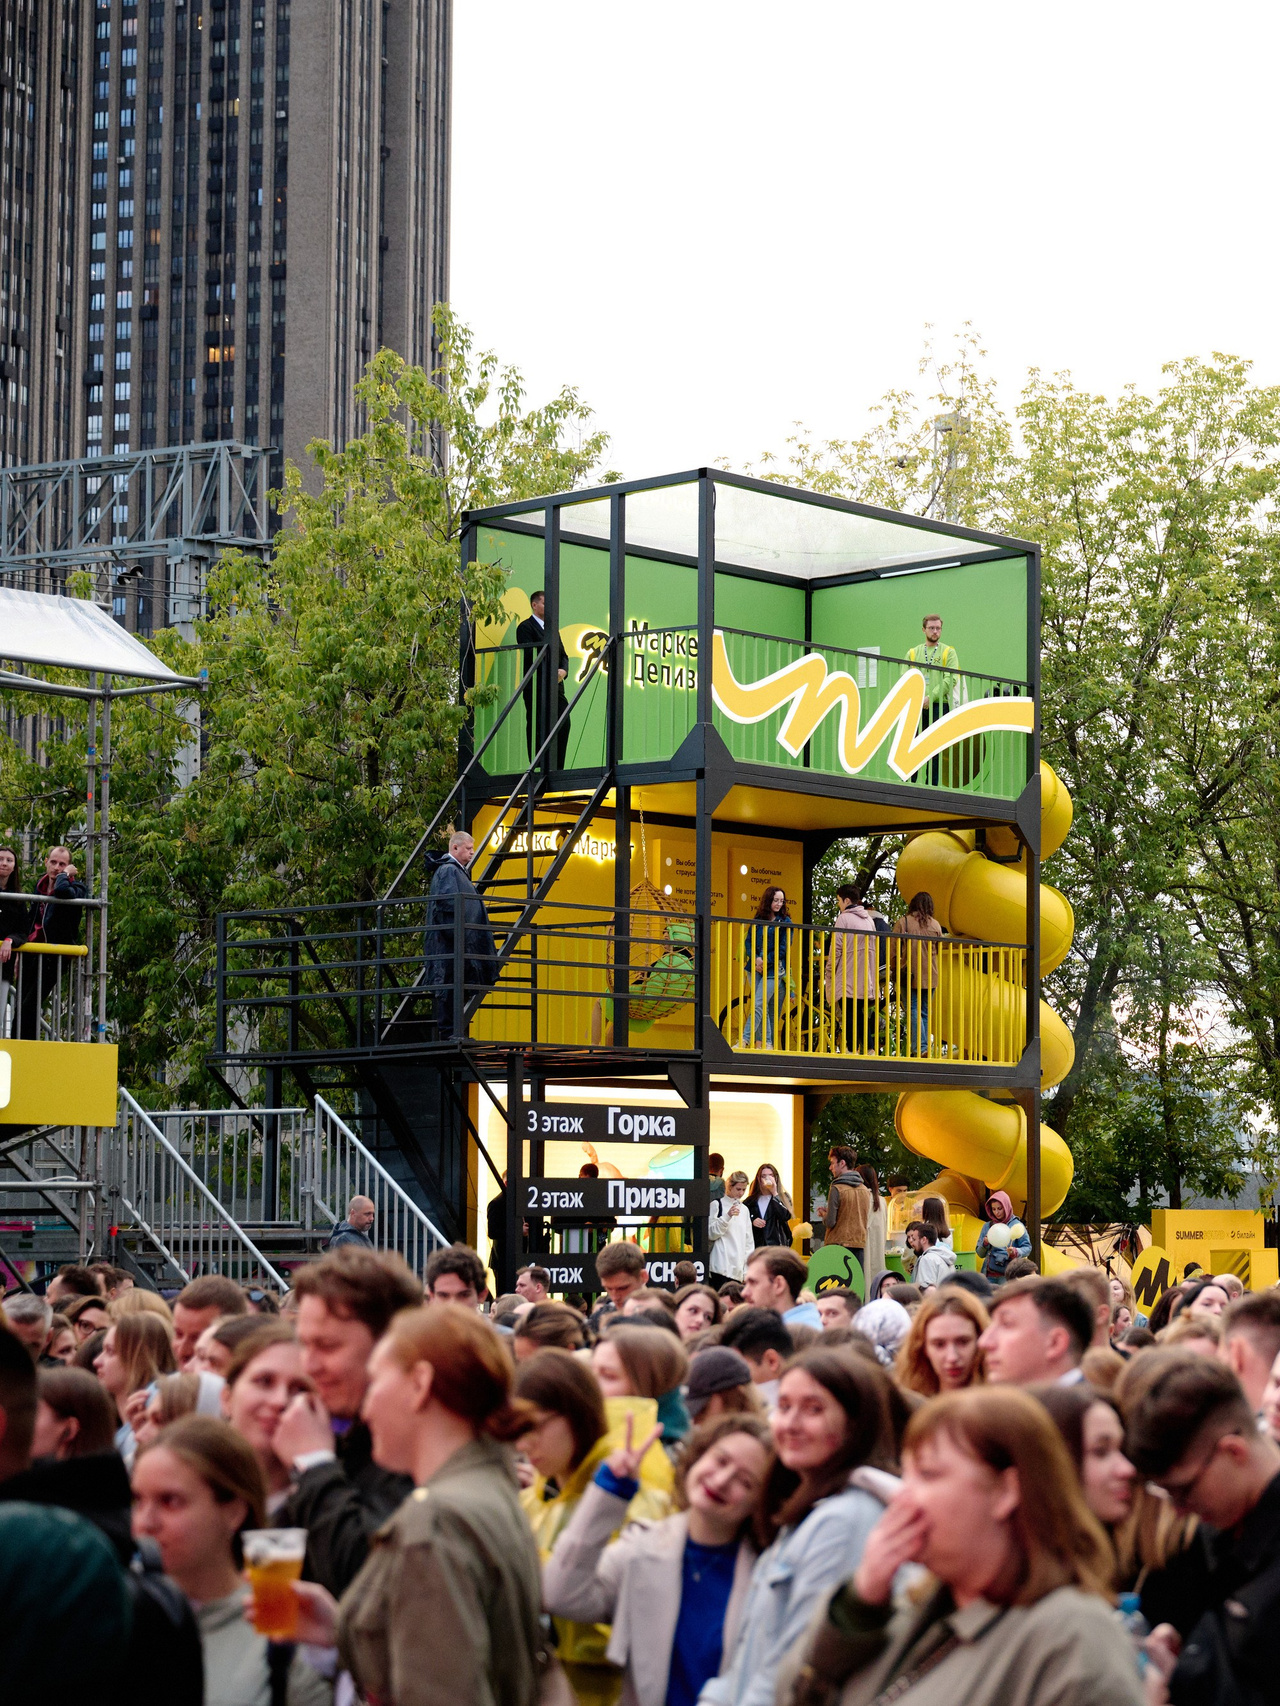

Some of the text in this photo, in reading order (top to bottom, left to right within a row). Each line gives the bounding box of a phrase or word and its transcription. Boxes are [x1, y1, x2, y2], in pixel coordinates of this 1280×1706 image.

[632, 620, 698, 657] Марке
[634, 653, 697, 688] Делив
[676, 869, 696, 877] страуса
[527, 1107, 676, 1141] 3 этаж Горка
[527, 1180, 685, 1214] 2 этаж Призы
